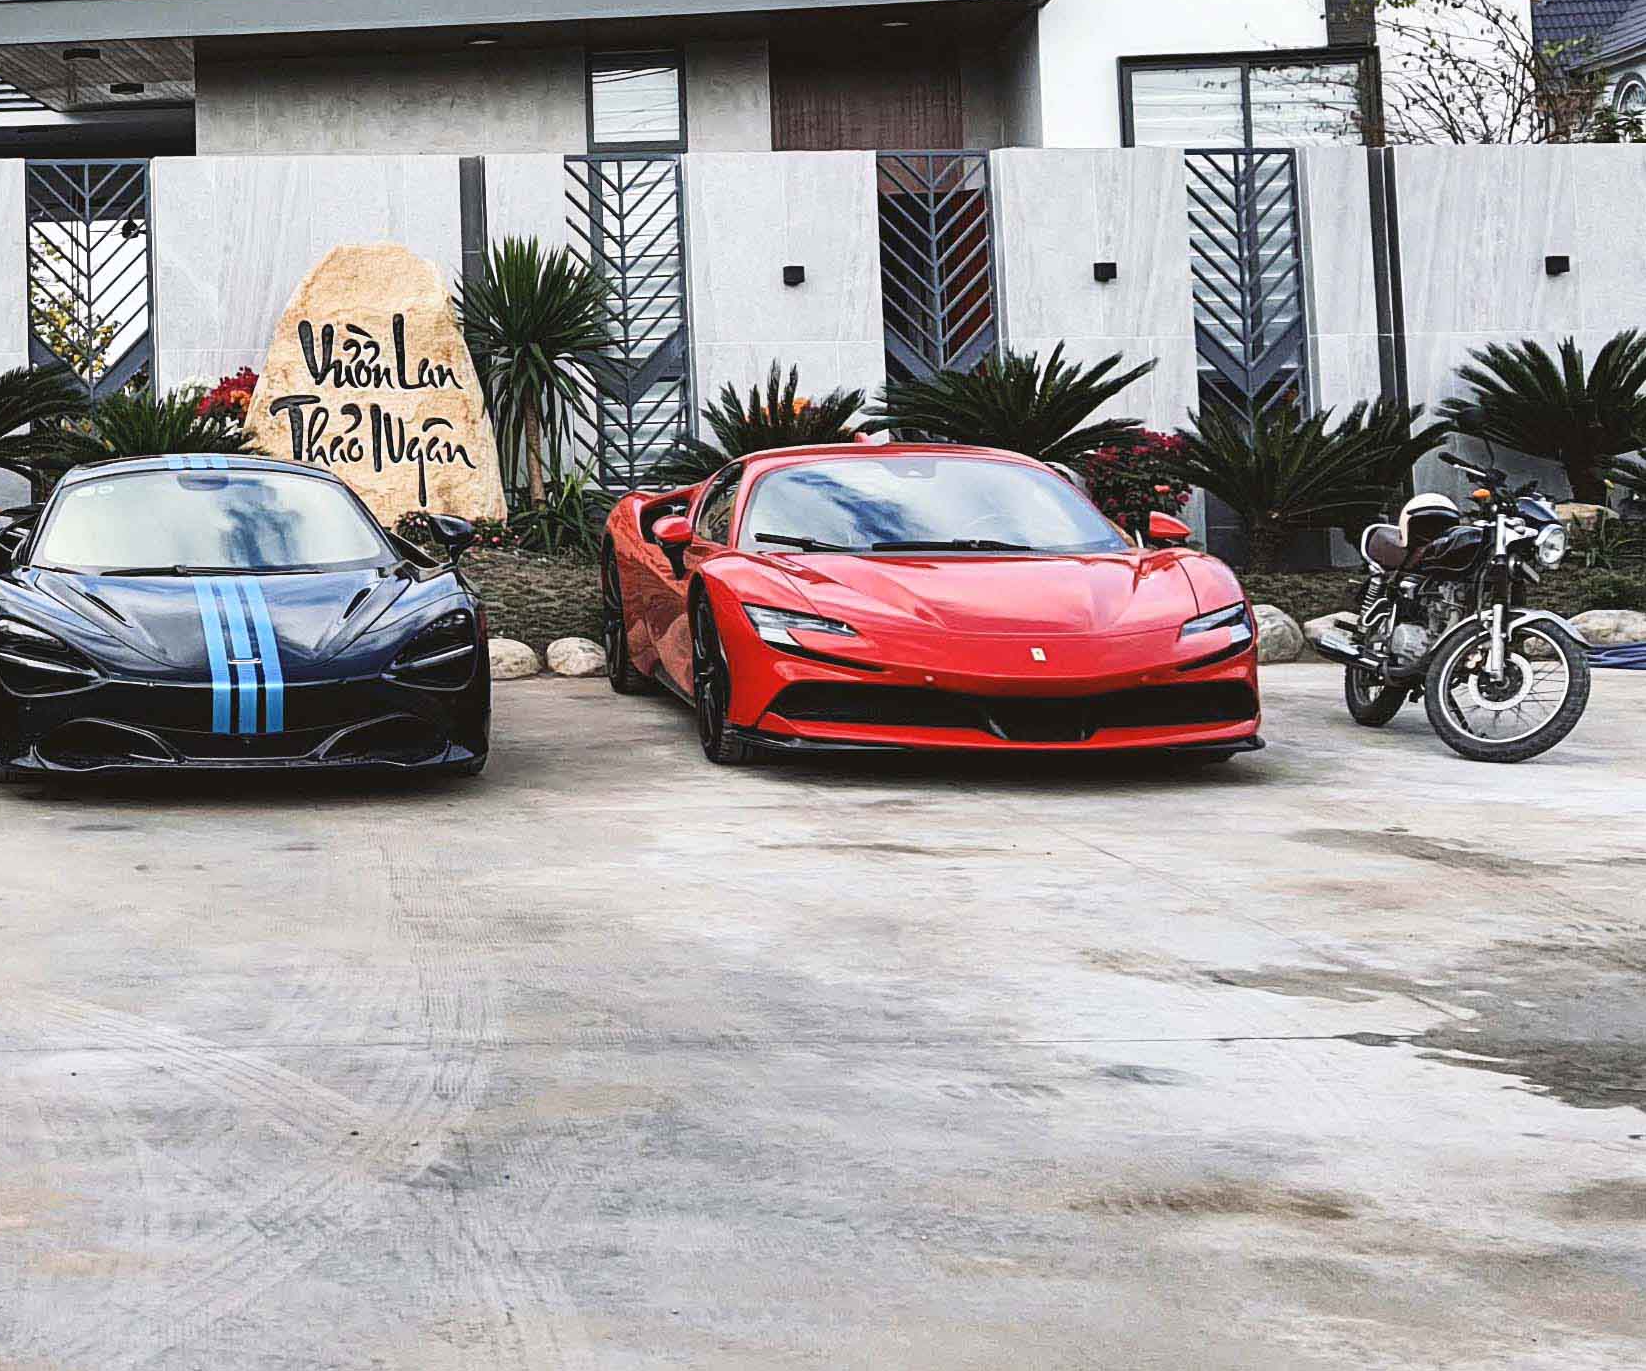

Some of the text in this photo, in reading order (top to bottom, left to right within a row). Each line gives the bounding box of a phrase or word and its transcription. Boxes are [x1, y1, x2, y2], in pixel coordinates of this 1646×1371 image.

[393, 313, 463, 389] Lan
[269, 394, 476, 507] Thảo Ngân
